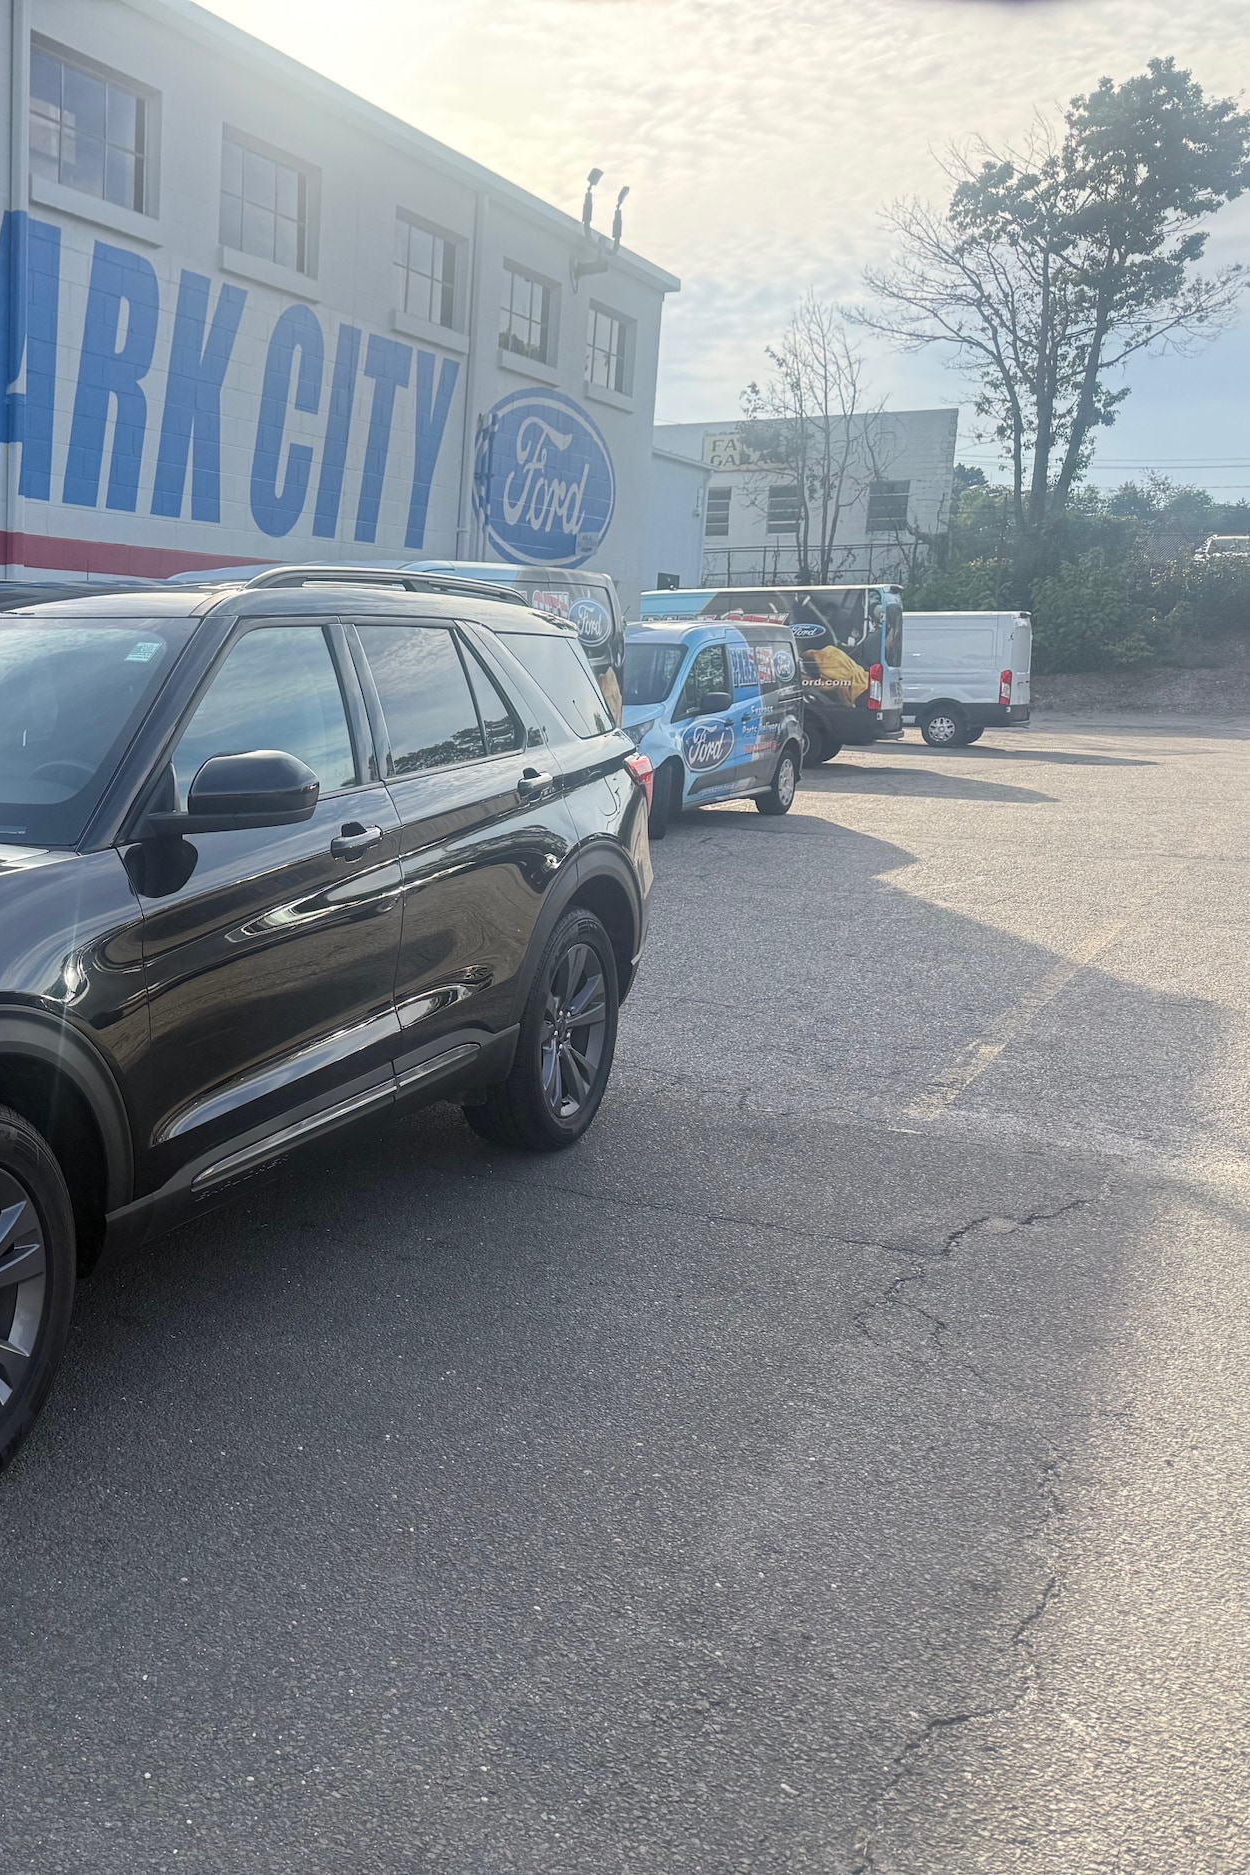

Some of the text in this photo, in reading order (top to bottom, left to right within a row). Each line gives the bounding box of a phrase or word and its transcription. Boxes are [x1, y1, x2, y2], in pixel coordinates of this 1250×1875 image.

[249, 302, 461, 549] CITY
[503, 416, 591, 536] Ford
[578, 605, 602, 636] Ford
[791, 626, 816, 636] Ford
[801, 678, 852, 687] ord.com
[688, 725, 725, 766] Ford
